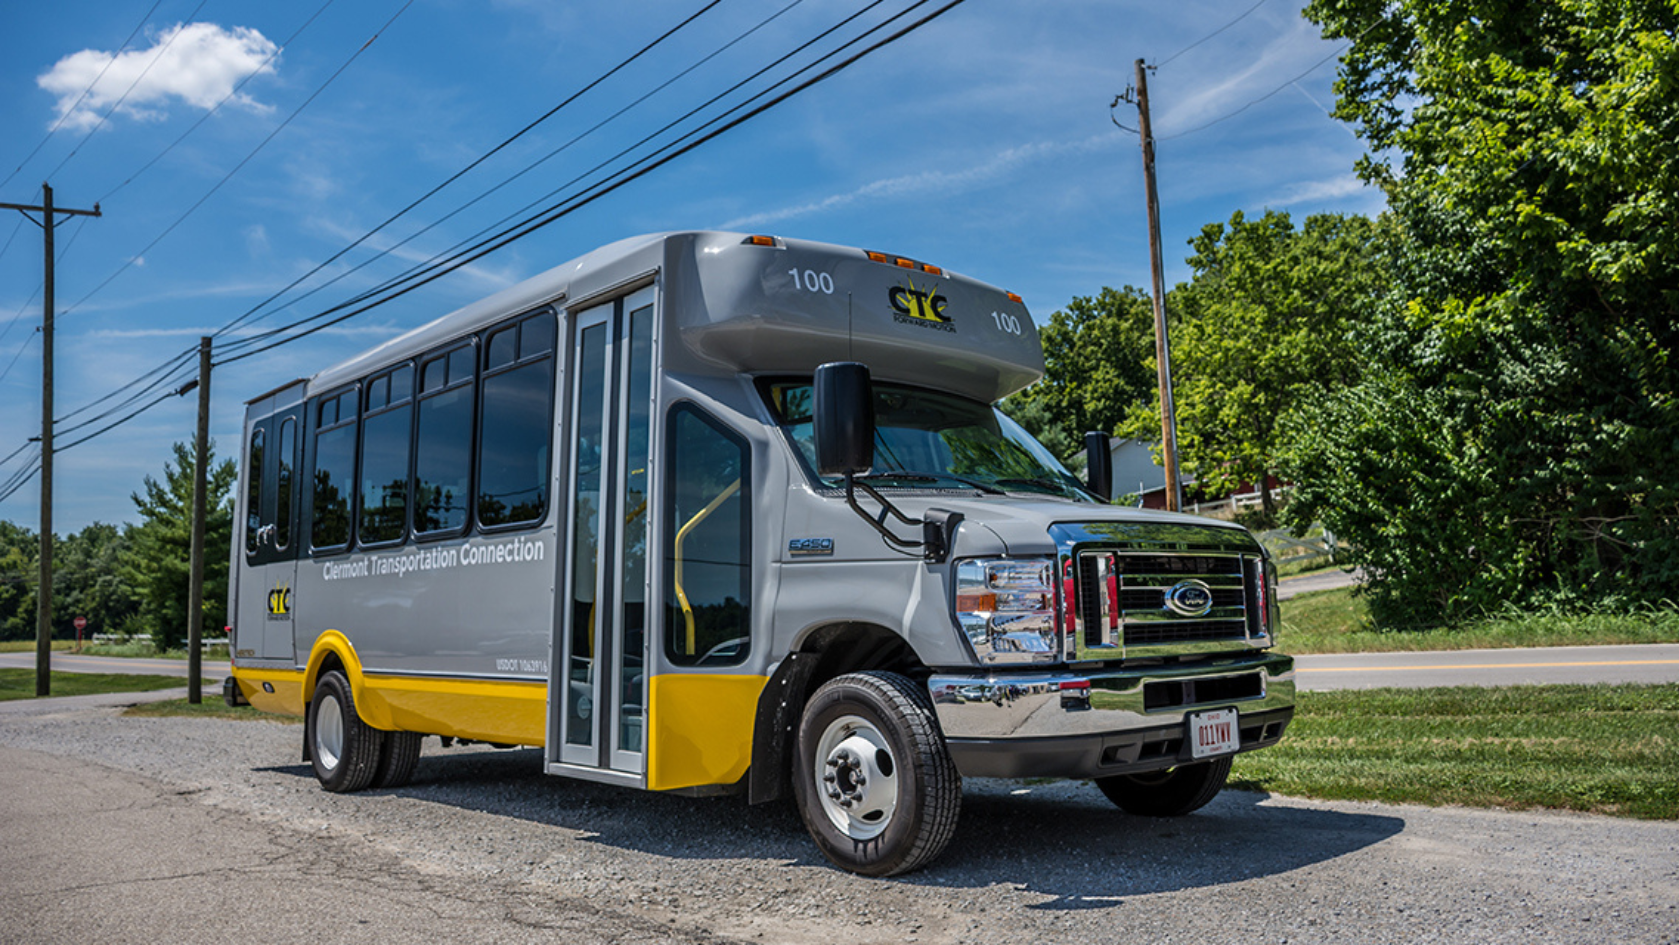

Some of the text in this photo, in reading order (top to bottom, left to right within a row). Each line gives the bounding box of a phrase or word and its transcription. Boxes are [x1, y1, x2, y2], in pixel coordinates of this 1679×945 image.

[788, 268, 834, 294] 100
[888, 286, 952, 322] CTC
[991, 311, 1021, 336] 100
[789, 538, 832, 550] E450
[322, 537, 544, 581] Clermont Transportation Connection
[267, 588, 290, 613] CTC
[496, 659, 518, 671] USDOT
